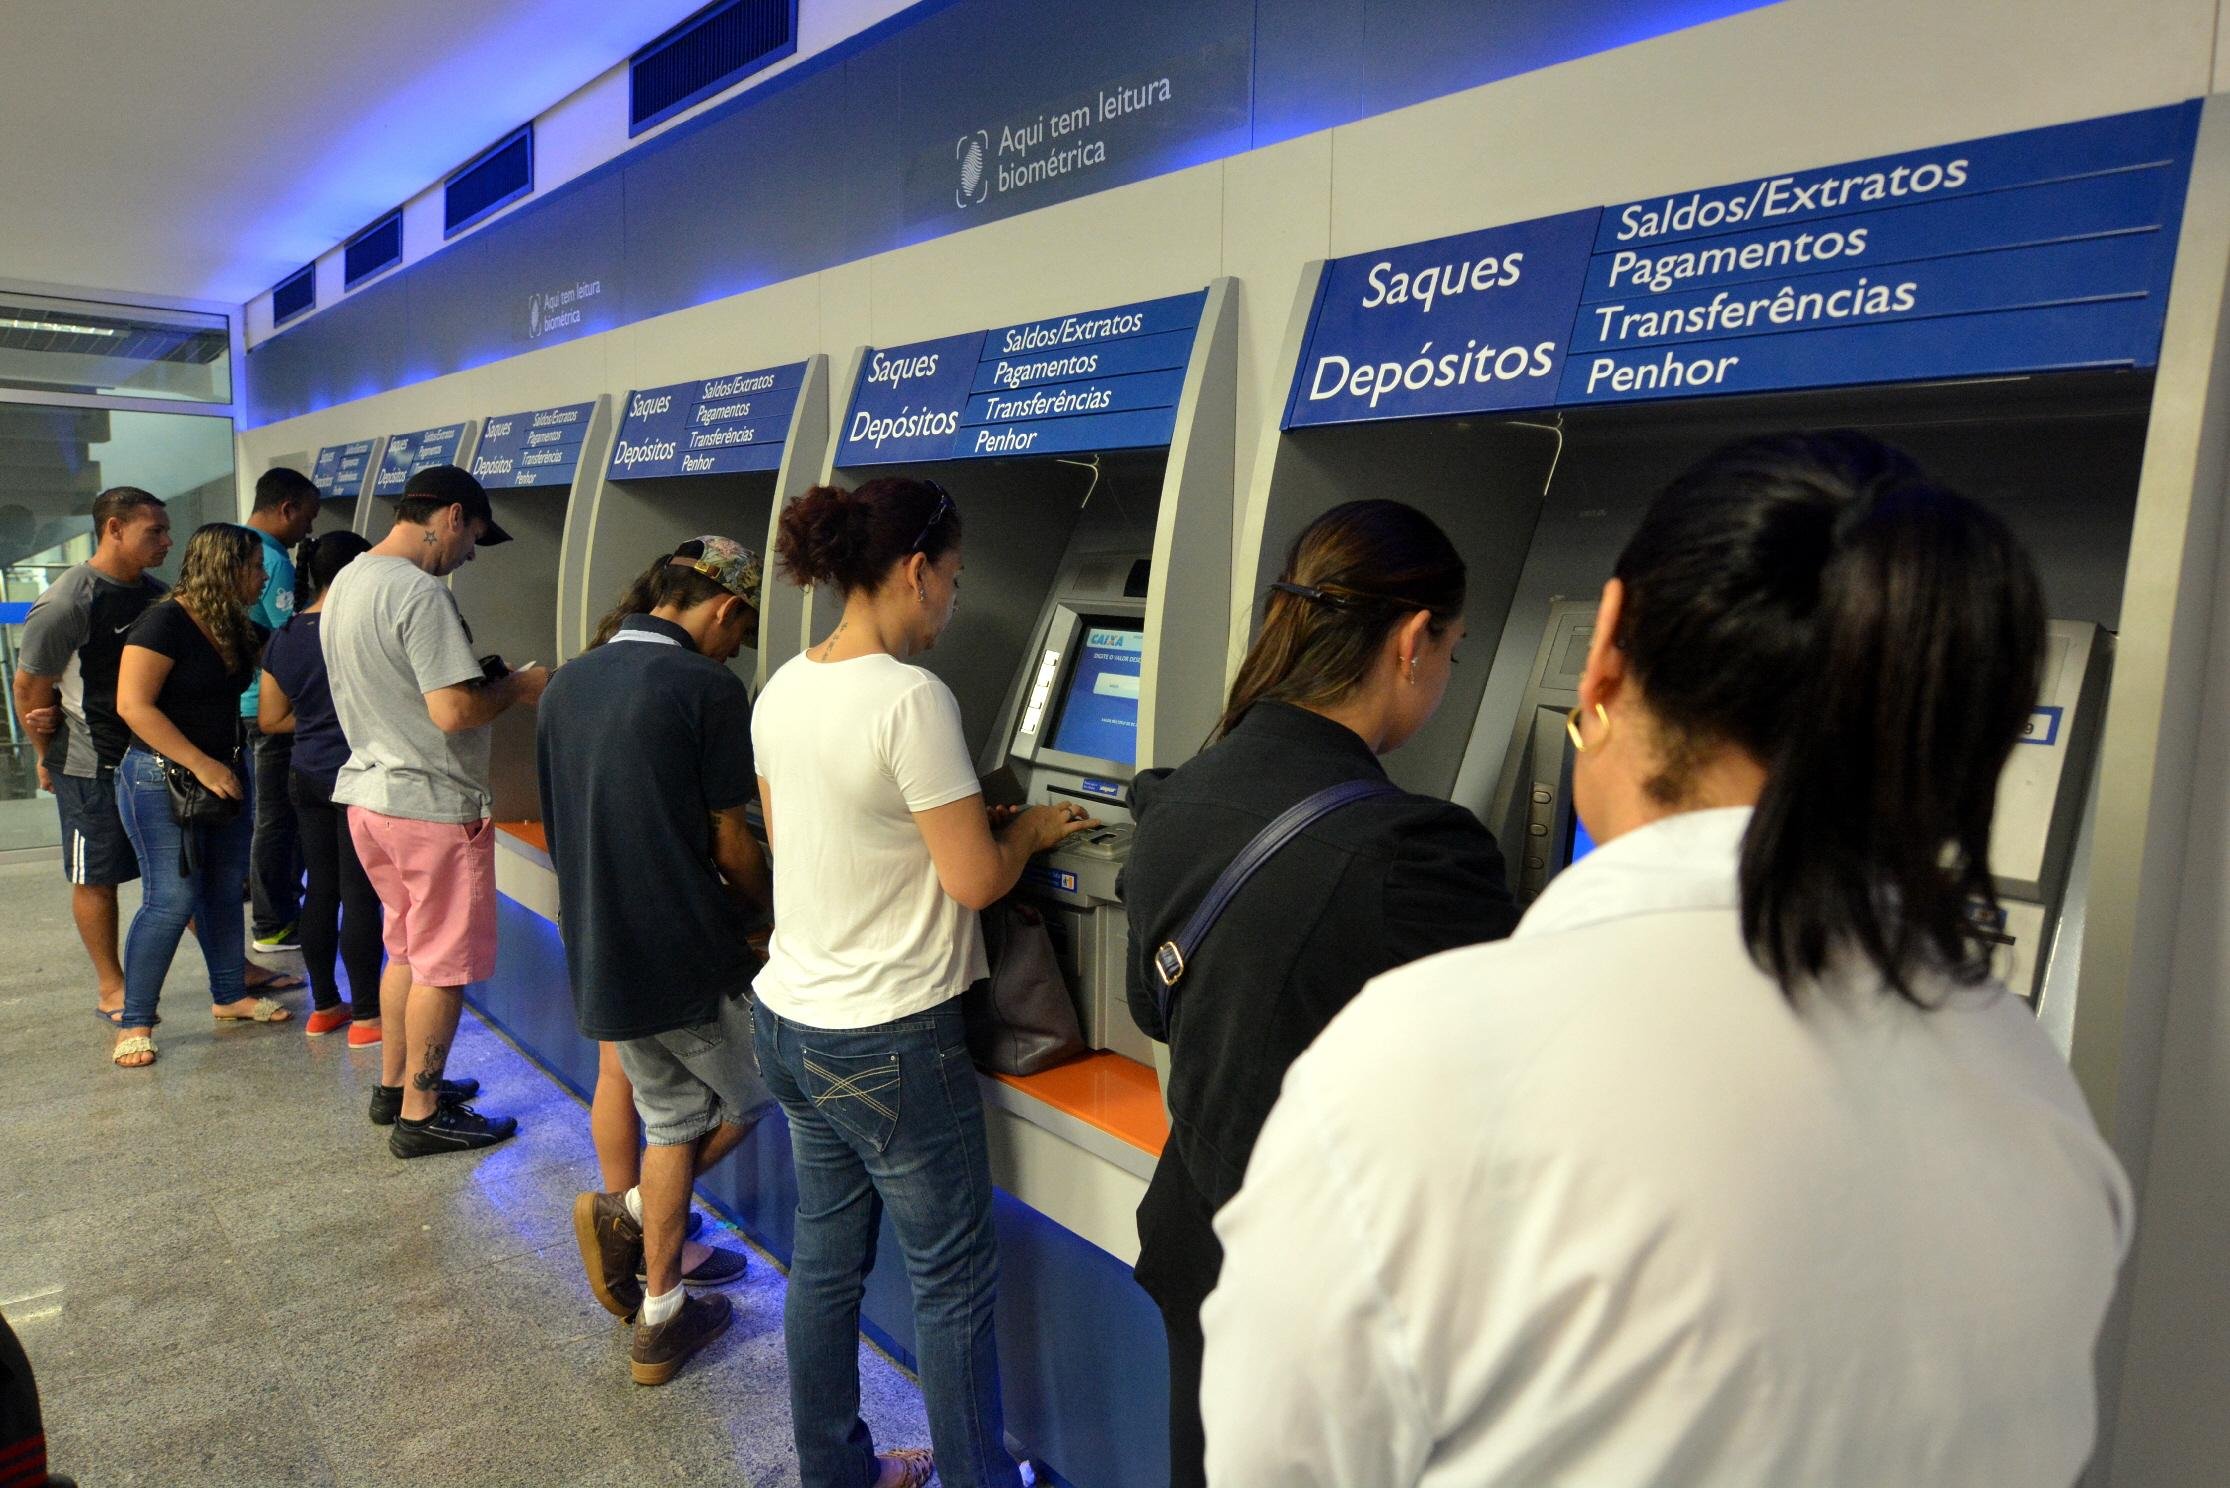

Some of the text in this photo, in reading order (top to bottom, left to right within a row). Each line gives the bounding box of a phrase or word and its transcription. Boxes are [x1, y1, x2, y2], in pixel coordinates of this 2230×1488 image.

[999, 78, 1171, 158] Aqui tem leitura
[999, 141, 1106, 192] biométrica
[1616, 158, 1970, 241] Saldos/Extratos
[1608, 225, 1868, 293] Pagamentos
[544, 281, 600, 312] Aqui tem leitura
[1362, 251, 1524, 311] Saques
[544, 308, 580, 332] biométrica
[1595, 277, 1917, 343] Transferências
[1003, 313, 1143, 353] Saldos/Extratos
[867, 352, 939, 389] Saques
[993, 354, 1099, 389] Pagamentos
[1308, 338, 1556, 407] Depósitos
[1586, 351, 1739, 394] Penhor
[702, 373, 774, 400] Saldos/Extratos
[533, 410, 578, 427] Saldos/Extratos
[629, 393, 672, 423] Saques
[696, 402, 751, 426] Pagamentos
[984, 386, 1112, 421] Transferências
[485, 419, 512, 442] Saques
[527, 430, 562, 447] Pagamentos
[689, 425, 755, 449] Transferências
[850, 405, 959, 448] Depósitos
[974, 428, 1038, 453] Penhor
[473, 455, 513, 480] Depósitos
[522, 448, 563, 466] Transferências
[614, 438, 676, 470] Depósitos
[681, 453, 715, 472] Penhor
[515, 470, 536, 485] Penhor
[1091, 634, 1124, 647] CAIXA
